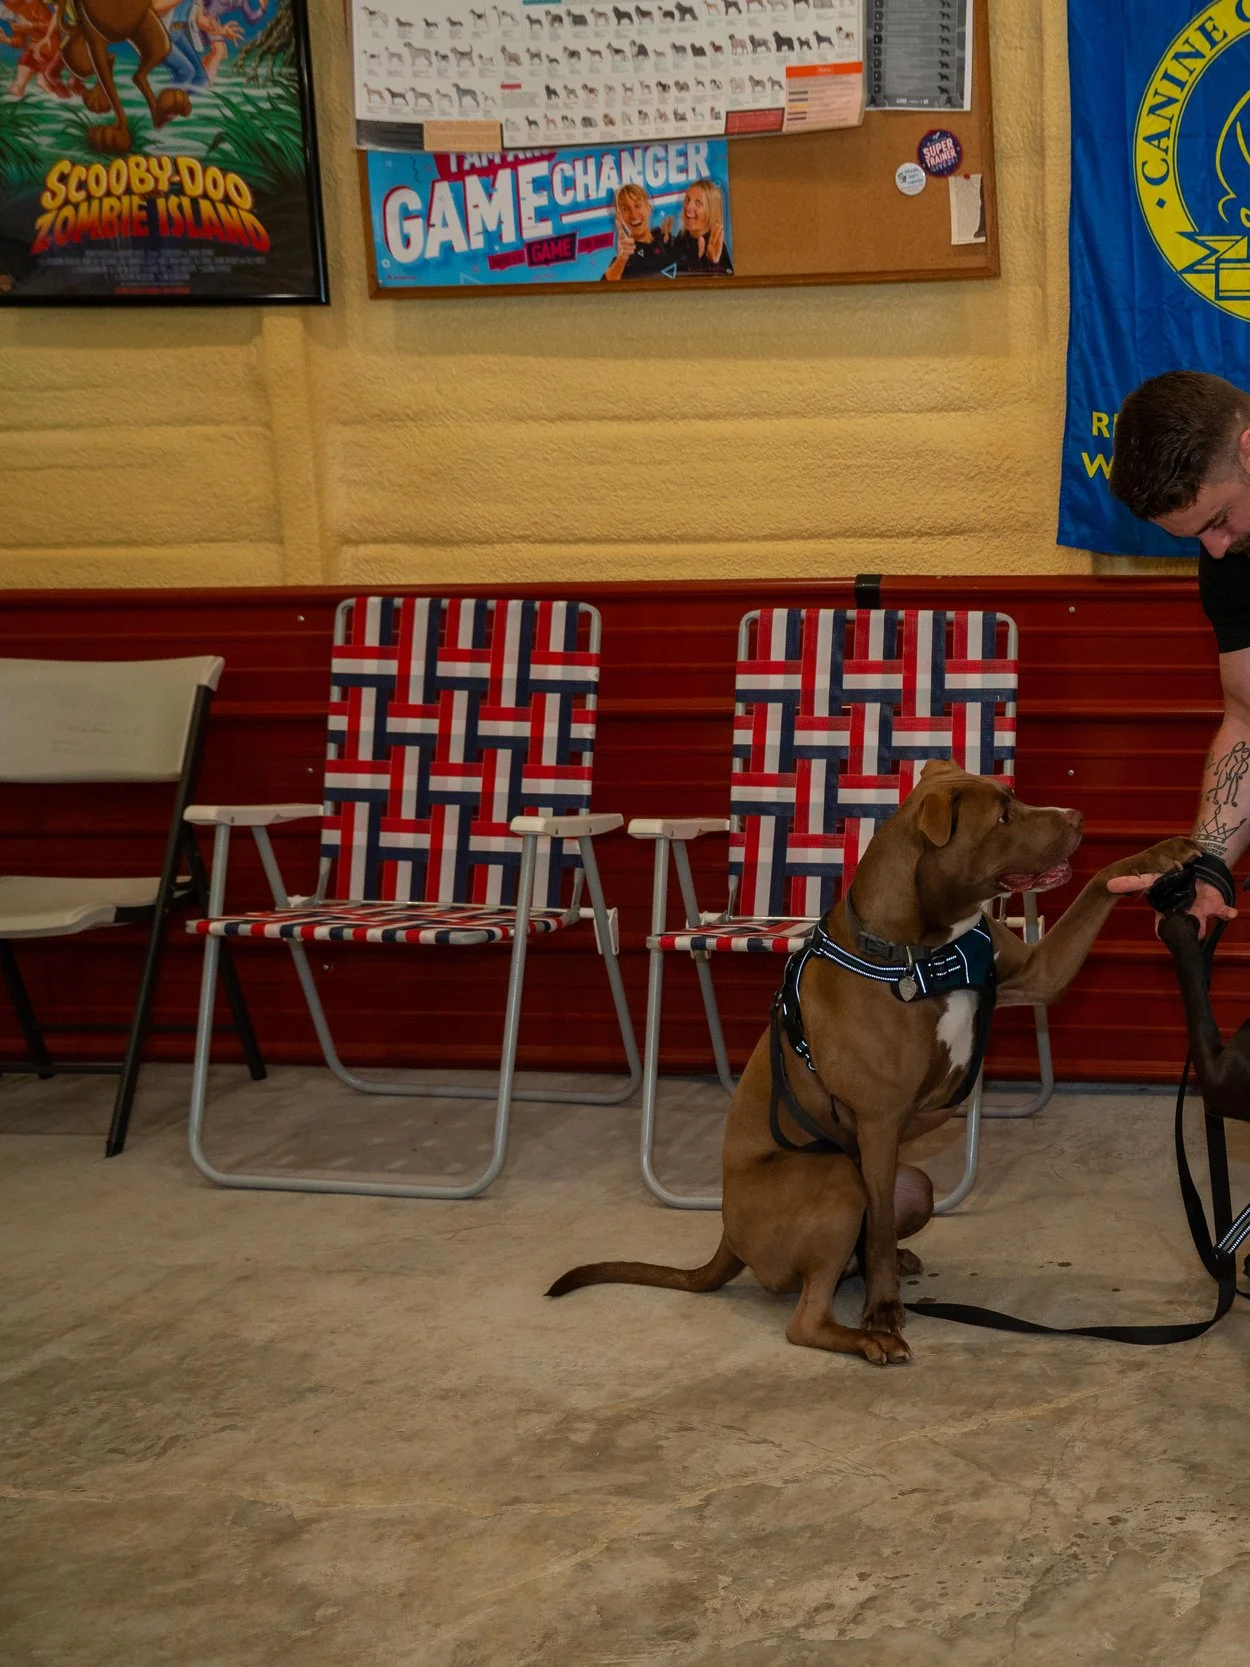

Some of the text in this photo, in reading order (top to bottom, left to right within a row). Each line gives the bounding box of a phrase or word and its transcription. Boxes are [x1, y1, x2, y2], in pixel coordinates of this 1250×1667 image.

[1143, 17, 1228, 187] CANINE
[552, 141, 713, 207] CHANGER
[923, 138, 954, 158] SUPER
[925, 149, 957, 168] TRAINER
[39, 155, 253, 211] SCOOBY-DOO
[30, 194, 271, 255] ZOMBIE ISLAND
[383, 161, 554, 265] GAME
[531, 238, 572, 263] GAME
